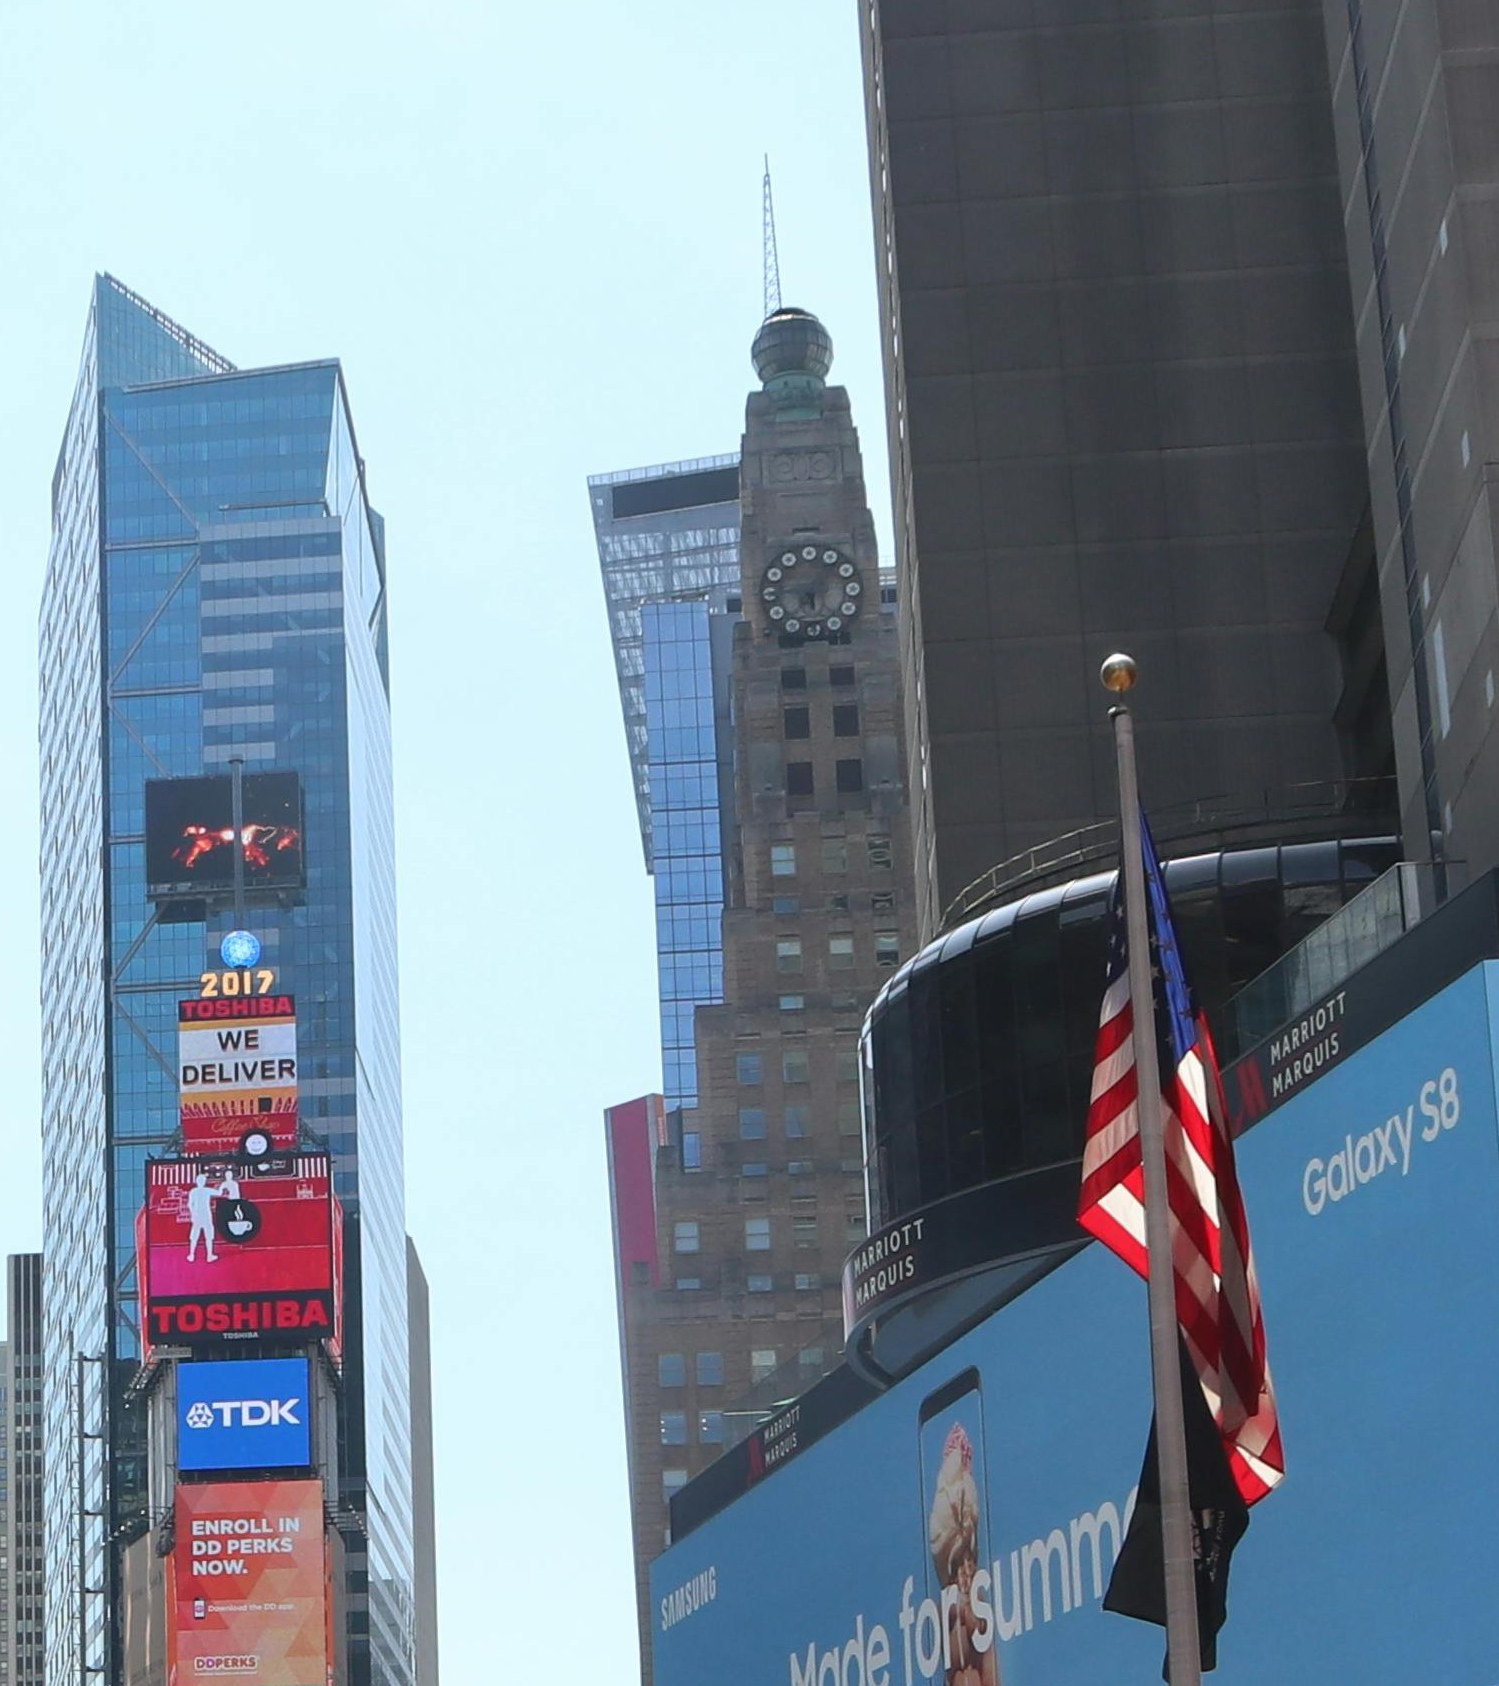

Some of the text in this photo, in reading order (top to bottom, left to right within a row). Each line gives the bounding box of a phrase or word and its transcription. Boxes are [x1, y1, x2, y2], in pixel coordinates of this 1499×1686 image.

[200, 970, 275, 997] 2017
[182, 996, 293, 1018] TOSHIBA
[217, 1029, 260, 1051] WE
[1269, 991, 1347, 1065] MARRIOTT
[182, 1059, 296, 1086] DELIVER
[1271, 1032, 1340, 1098] MARQUIS
[1303, 1067, 1461, 1215] Galaxy S8
[854, 1218, 924, 1279] MARRIOTT
[855, 1256, 915, 1308] MARQUIS
[152, 1300, 330, 1333] TOSHIBA
[222, 1331, 259, 1339] TOSHIBA
[212, 1399, 301, 1427] TDK
[763, 1405, 800, 1446] MARRIOTT
[764, 1432, 798, 1468] MARQUIS
[192, 1516, 300, 1536] ENROLL IN
[192, 1537, 293, 1556] DD PERKS
[192, 1559, 248, 1576] NOW.
[661, 1565, 717, 1631] SAMSUNG
[195, 1656, 256, 1670] DDPERKS
